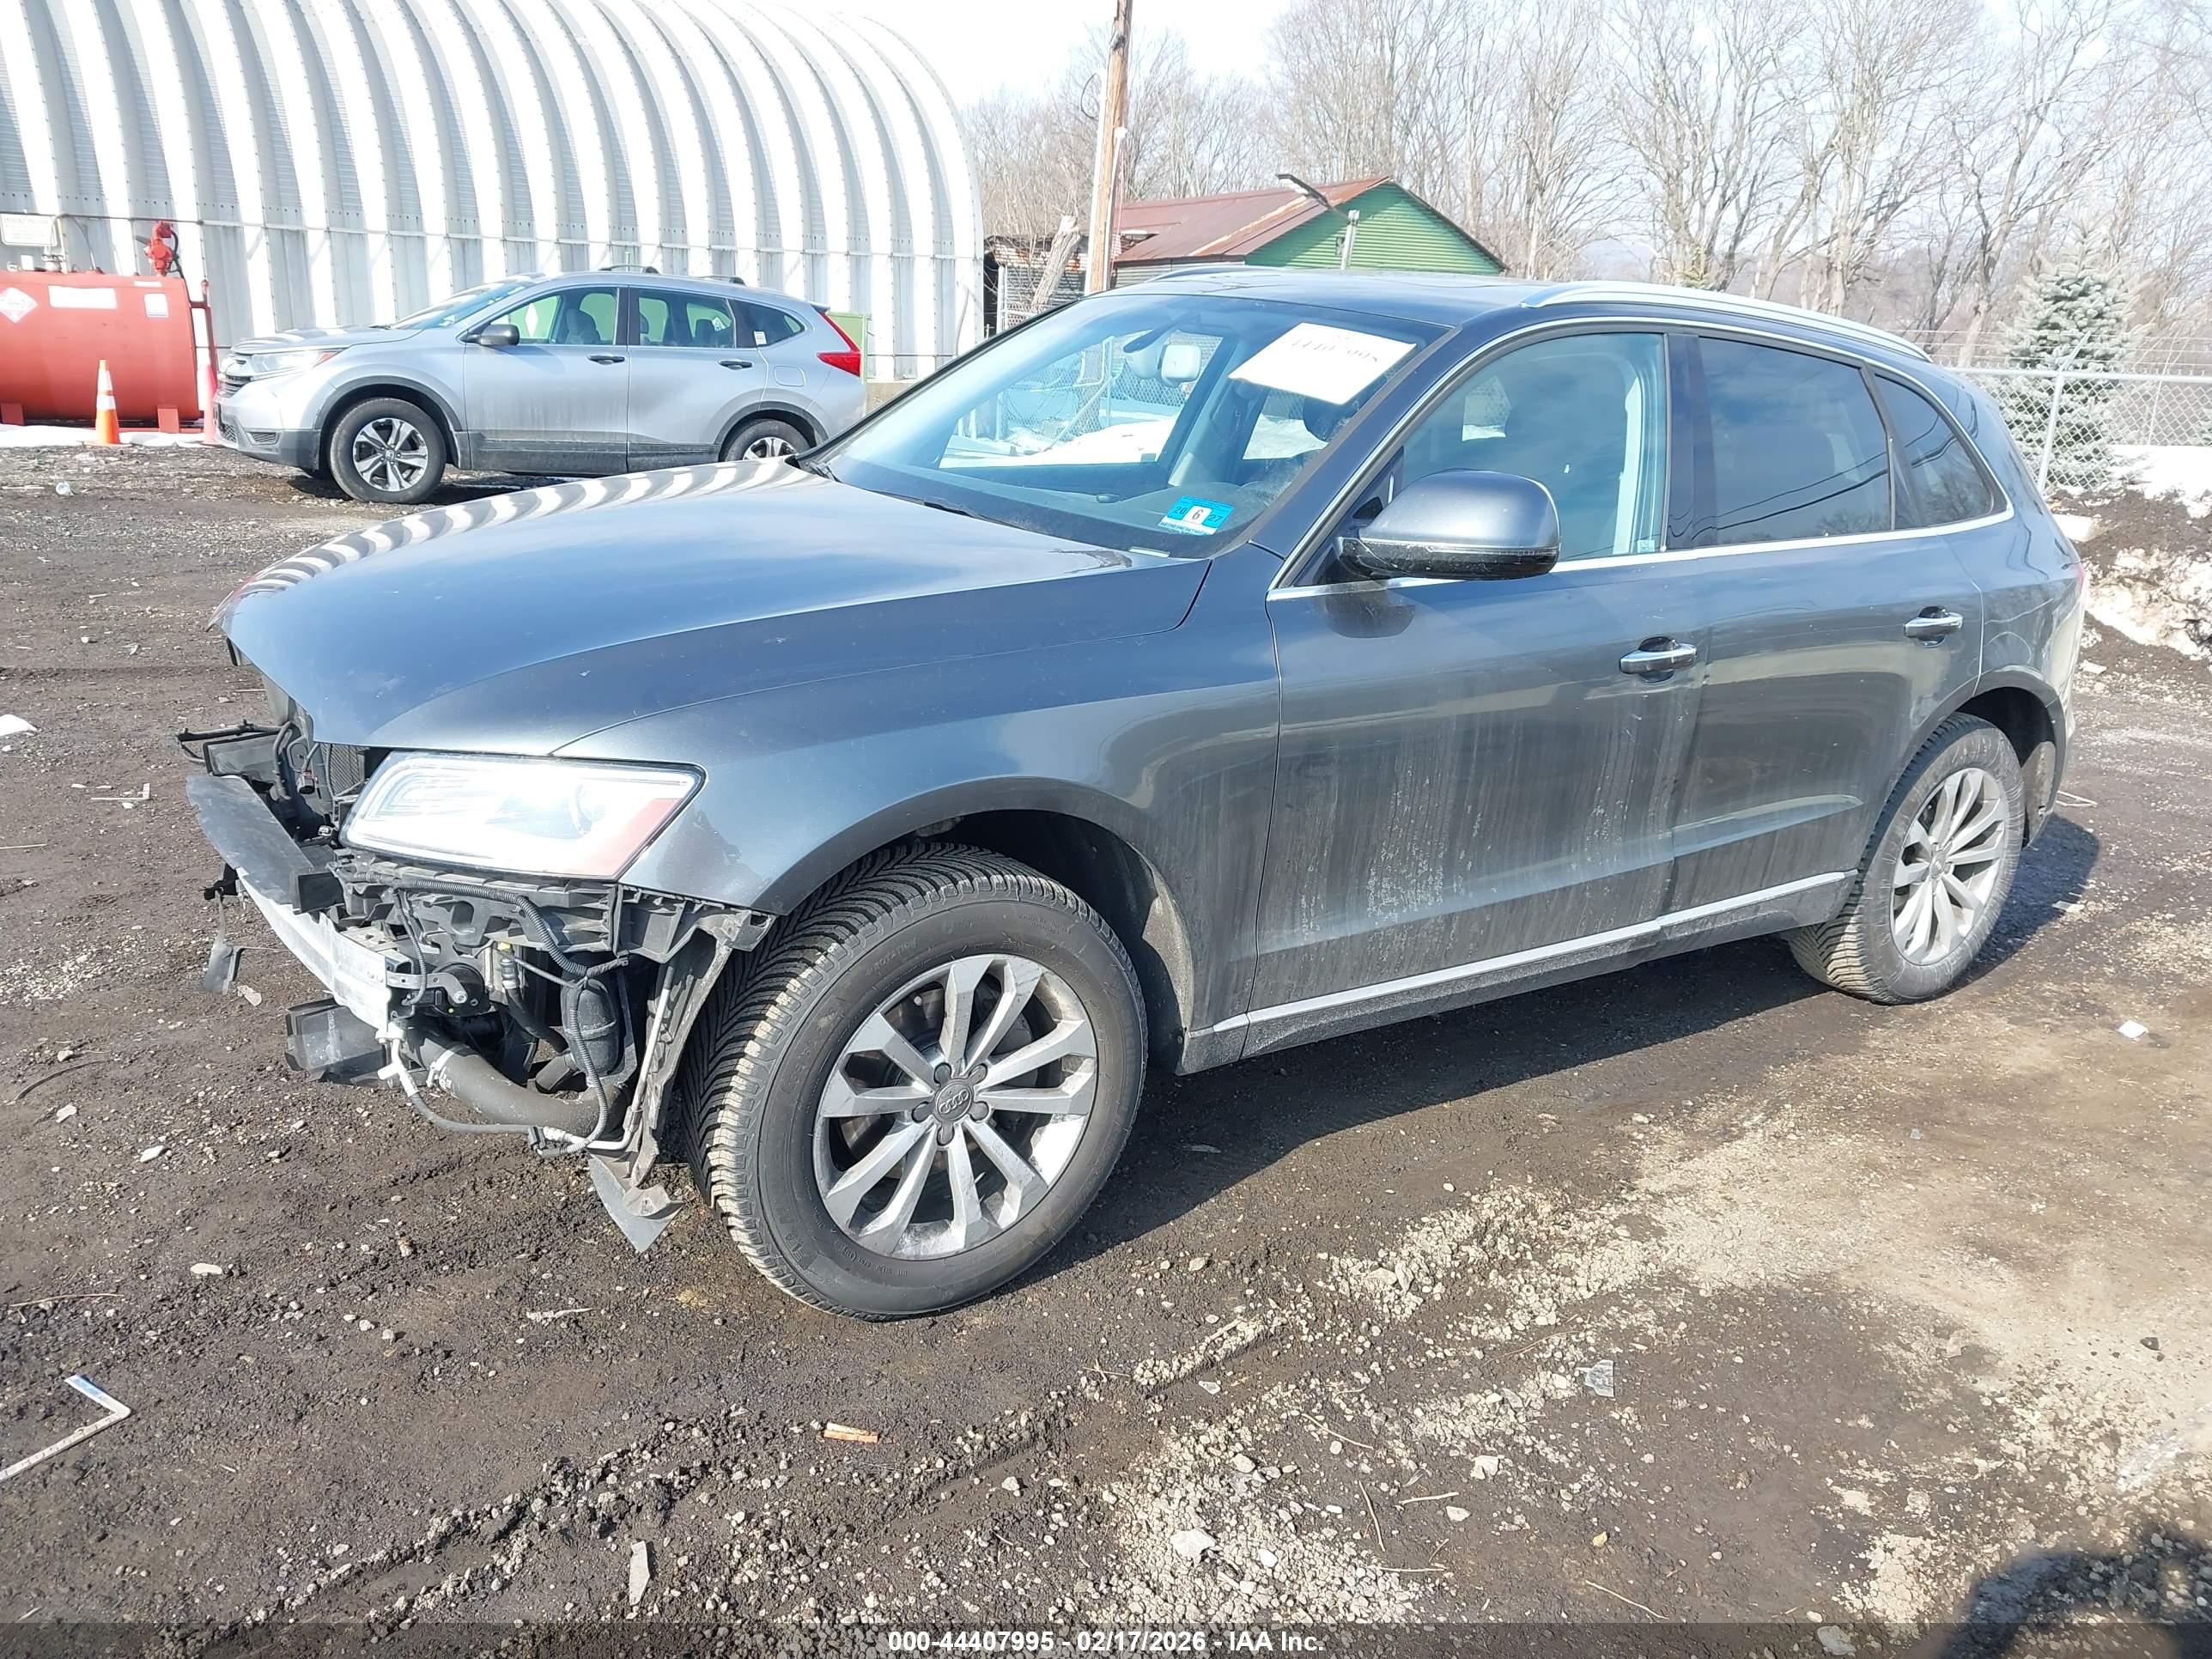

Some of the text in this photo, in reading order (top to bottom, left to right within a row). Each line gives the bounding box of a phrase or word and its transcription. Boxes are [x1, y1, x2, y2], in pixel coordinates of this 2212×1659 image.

[1173, 506, 1223, 523] 20 6 27
